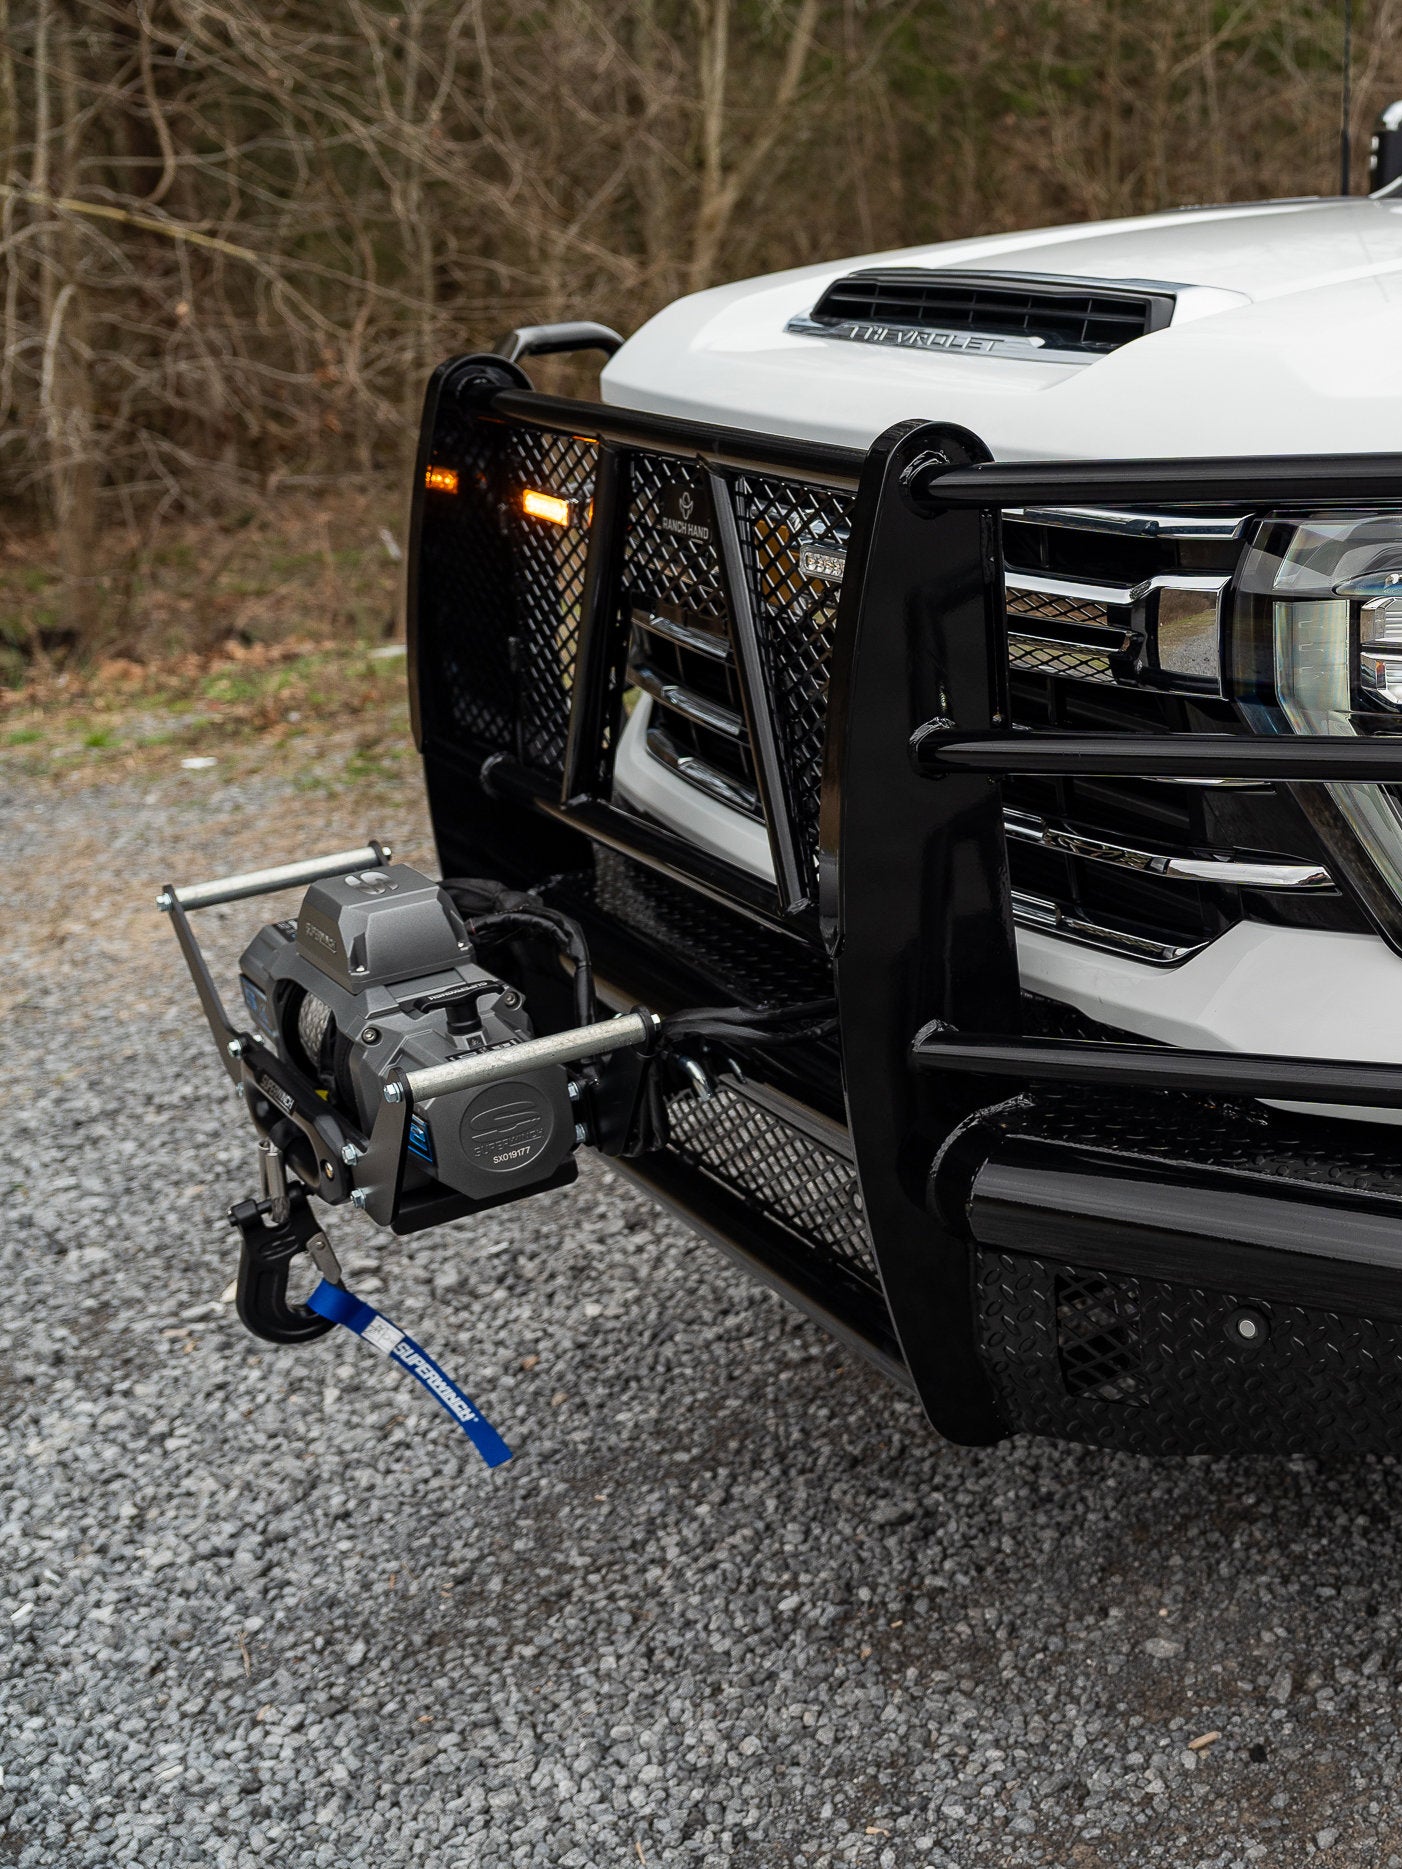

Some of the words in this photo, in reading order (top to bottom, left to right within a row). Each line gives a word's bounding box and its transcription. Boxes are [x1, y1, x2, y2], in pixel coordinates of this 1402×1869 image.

[850, 325, 1005, 352] CHEVROLET
[662, 517, 687, 534] RANCH
[687, 523, 709, 540] HAND
[492, 1145, 531, 1164] SX019177
[393, 1341, 476, 1423] SUPERWINCH
